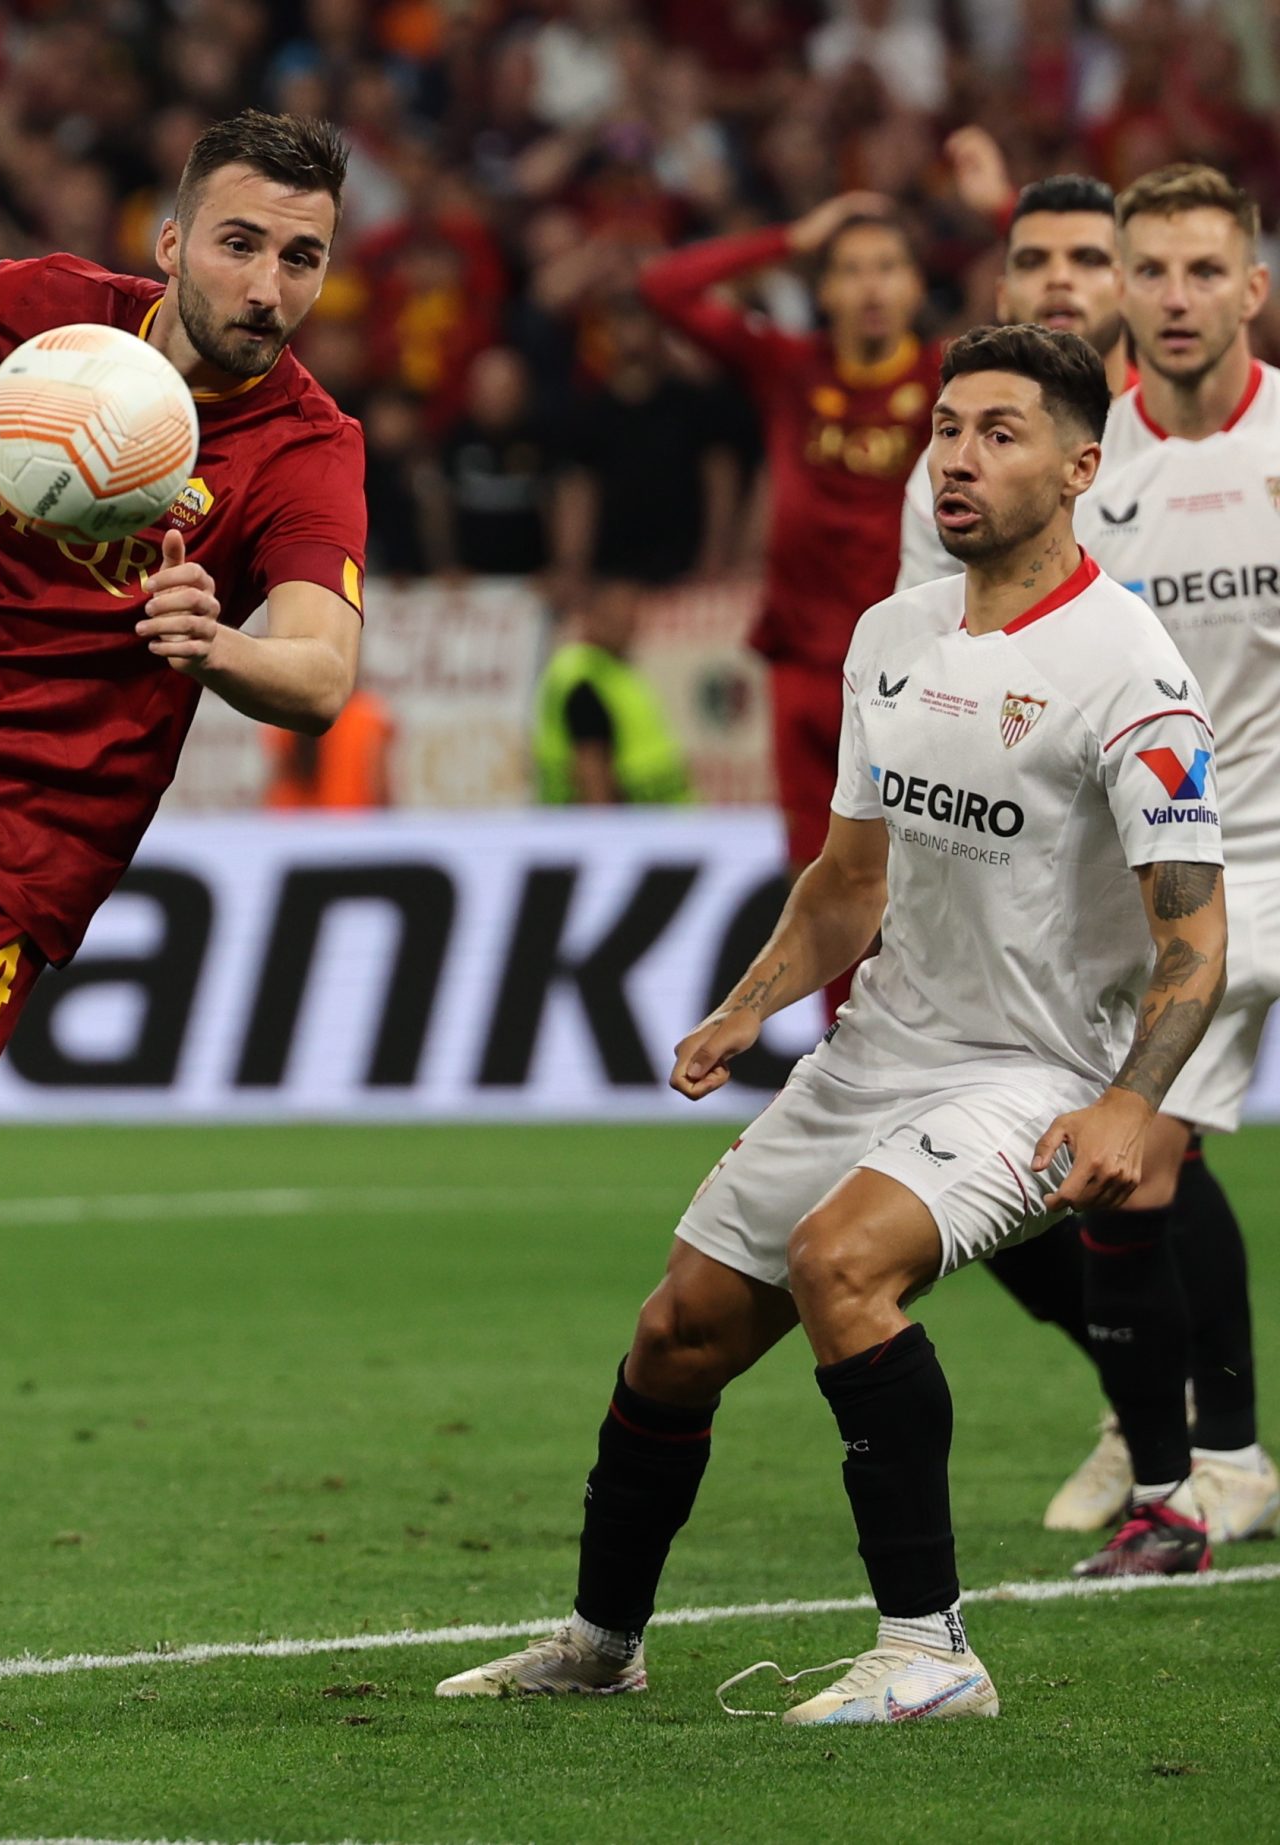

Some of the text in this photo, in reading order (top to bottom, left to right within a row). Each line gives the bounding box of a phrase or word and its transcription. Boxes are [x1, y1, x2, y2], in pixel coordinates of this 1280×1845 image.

[882, 769, 1025, 838] DEGIRO
[1141, 805, 1219, 826] Valvoline
[898, 826, 1011, 866] LEADING BROKER
